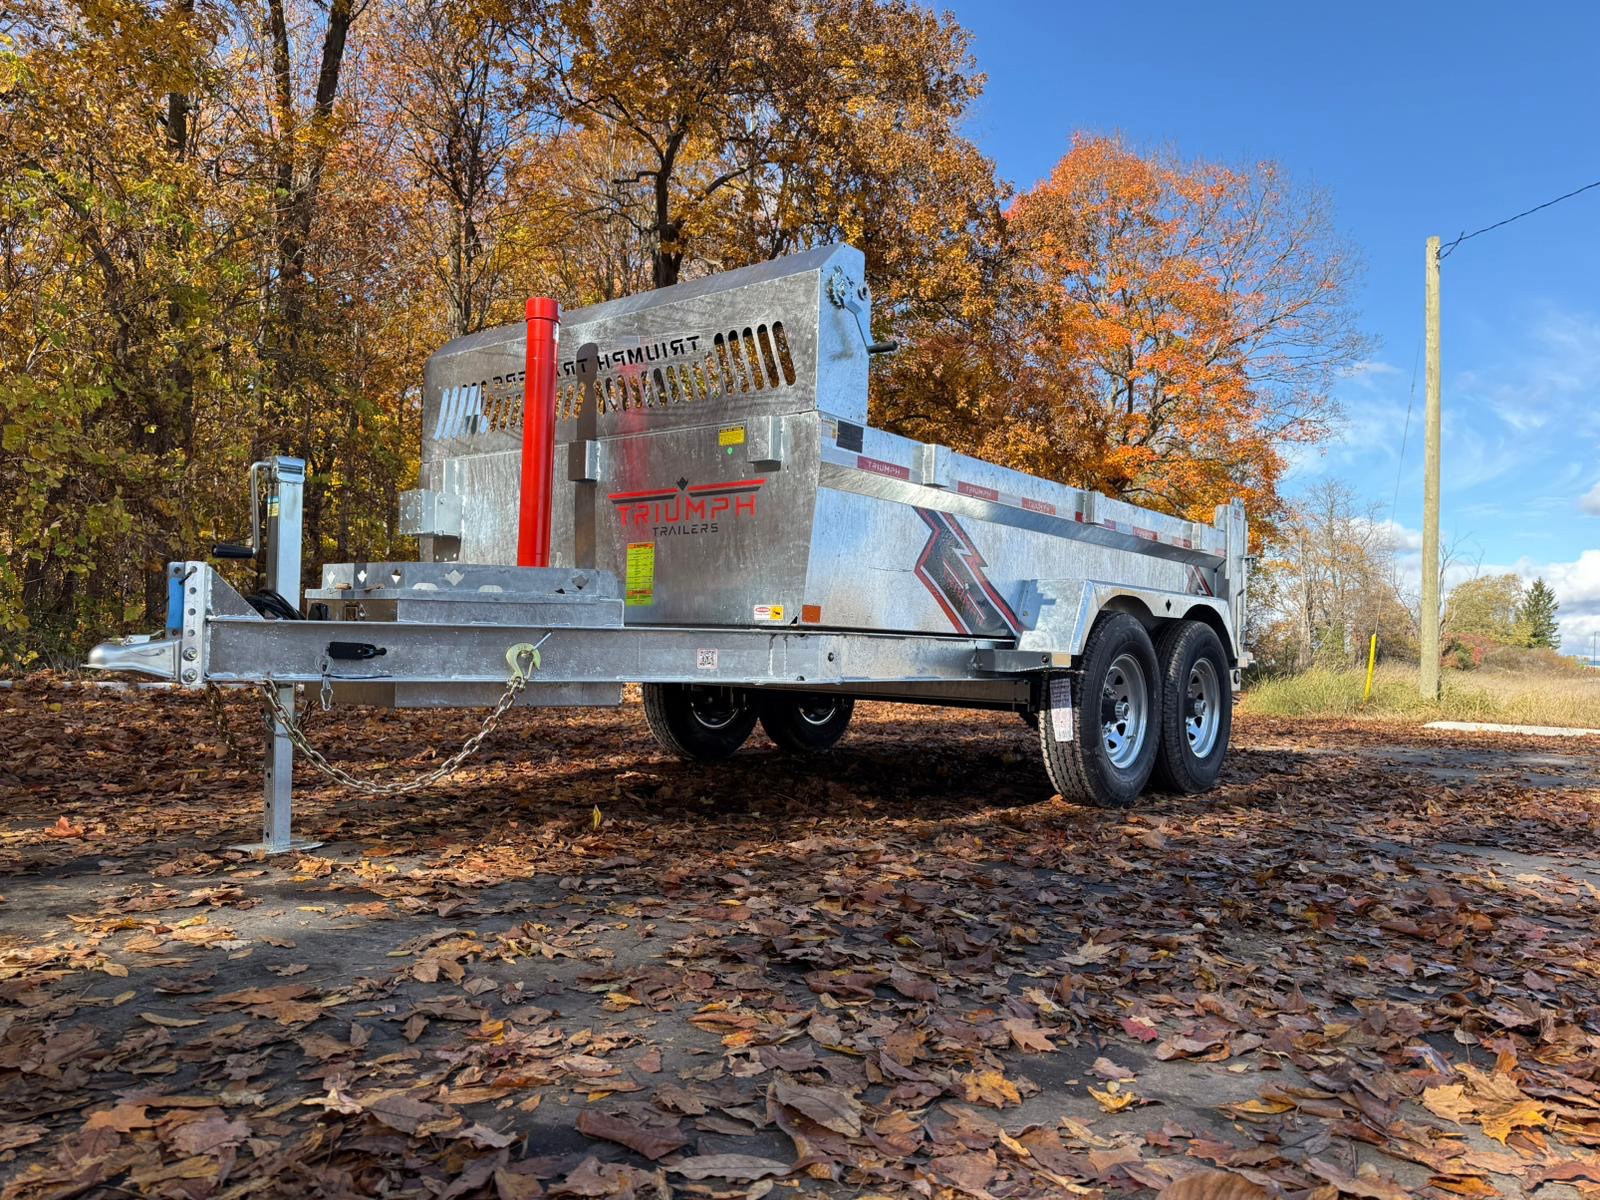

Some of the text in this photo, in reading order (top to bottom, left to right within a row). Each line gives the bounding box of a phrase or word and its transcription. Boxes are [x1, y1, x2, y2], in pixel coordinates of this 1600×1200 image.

[868, 460, 902, 476] TRIUMPH
[616, 494, 757, 528] TRIUMPH
[652, 522, 719, 537] TRAILERS
